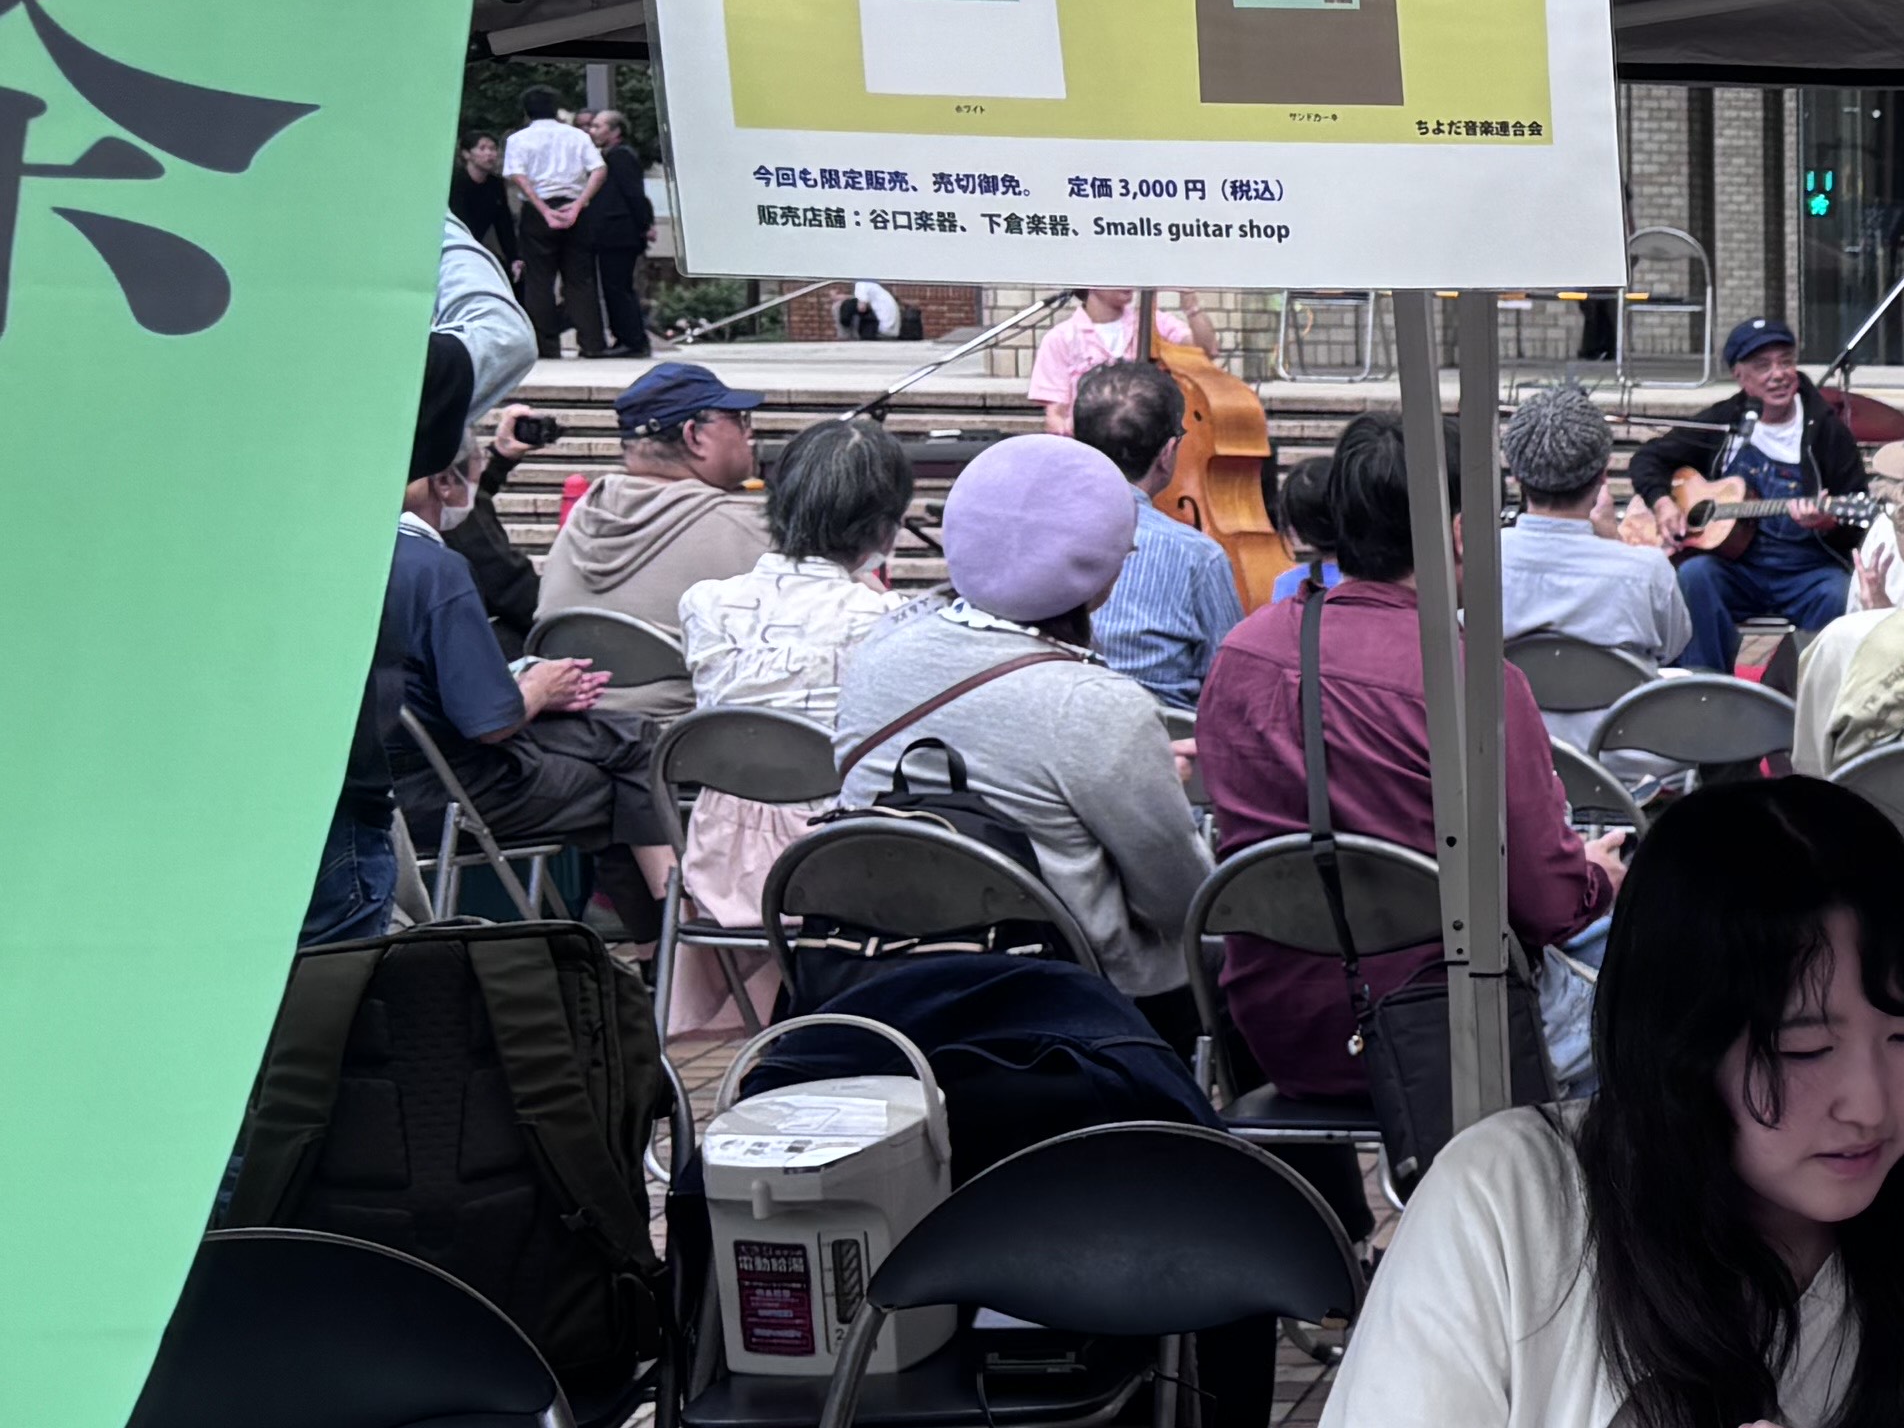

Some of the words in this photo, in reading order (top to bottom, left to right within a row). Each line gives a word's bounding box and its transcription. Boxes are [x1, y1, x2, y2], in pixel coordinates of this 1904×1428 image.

[1416, 119, 1544, 139] ちよだ音楽連合会
[753, 164, 1032, 198] 今回も限定販売、売切御免。
[1093, 216, 1162, 237] Smalls
[1168, 217, 1233, 240] guitar
[1238, 218, 1291, 241] shop
